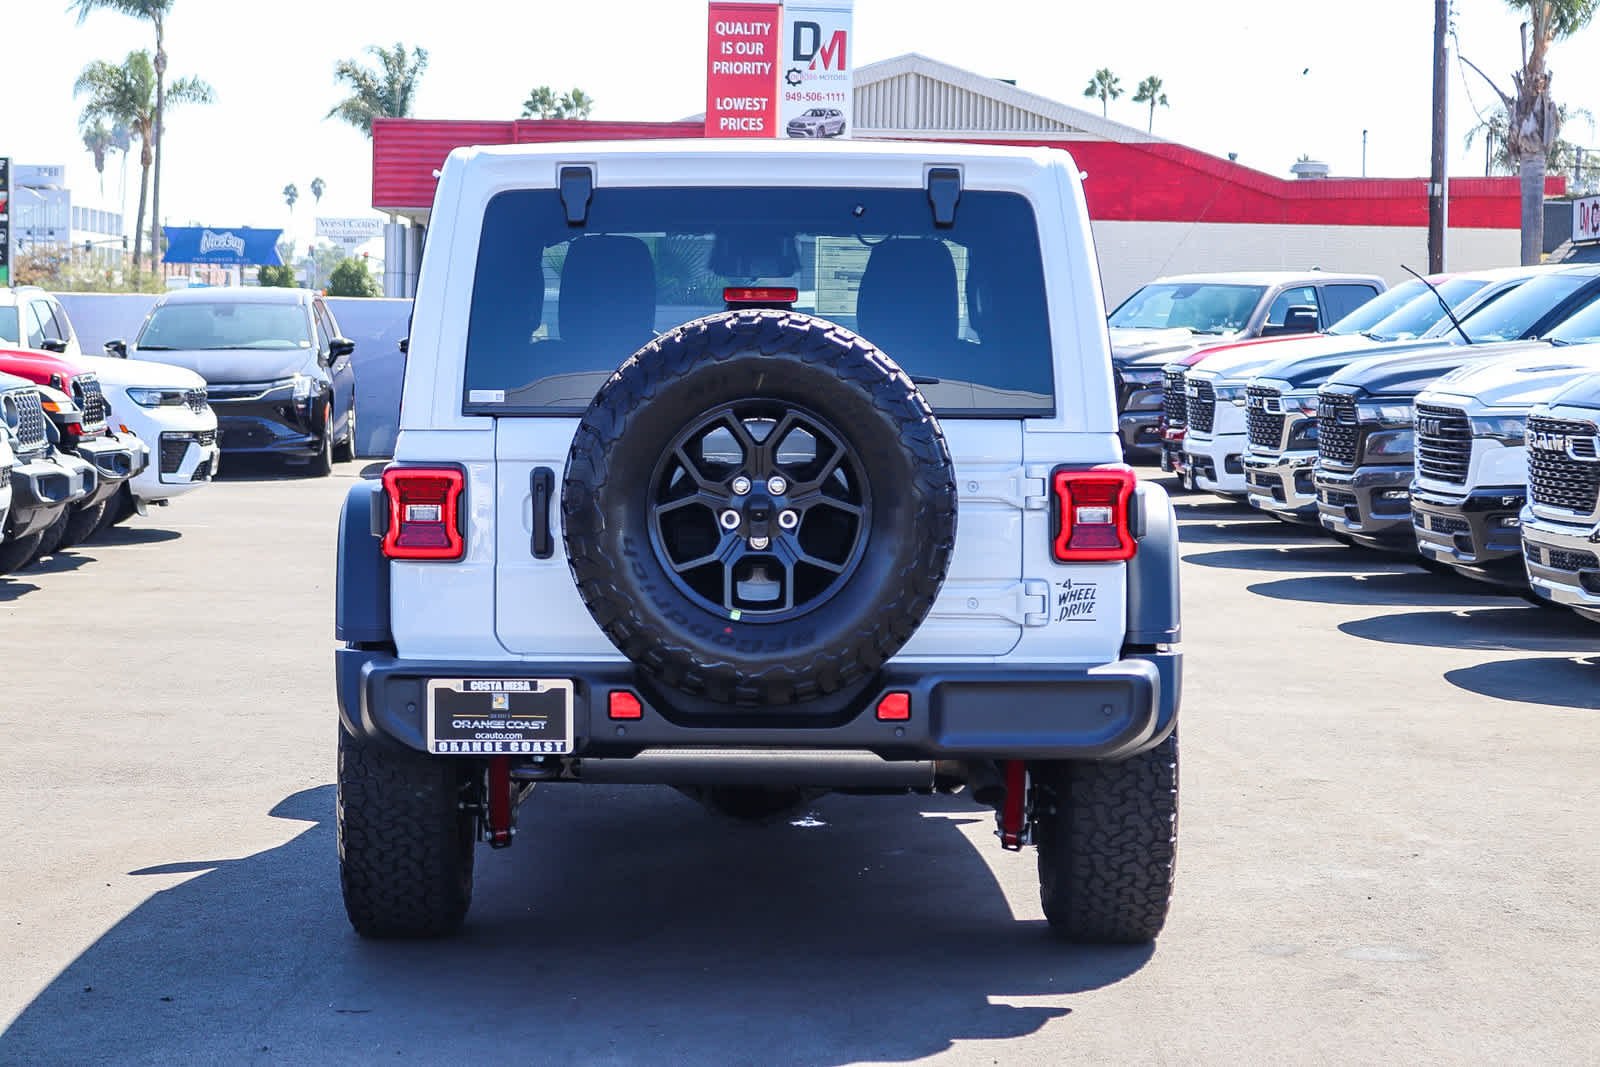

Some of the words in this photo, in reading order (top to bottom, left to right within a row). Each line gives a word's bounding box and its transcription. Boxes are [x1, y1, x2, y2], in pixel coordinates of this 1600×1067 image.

[715, 21, 771, 36] QUALITY
[721, 42, 733, 55] IS
[736, 42, 764, 55] OUR
[713, 61, 772, 75] PRIORITY
[785, 91, 846, 102] 949-506-1111
[716, 97, 768, 111] LOWEST
[720, 117, 764, 131] PRICES
[1062, 578, 1073, 590] 4
[1058, 587, 1097, 606] WHEEL
[1058, 601, 1096, 623] DRIVE
[470, 681, 502, 691] COSTA
[503, 681, 530, 691] MESA
[452, 720, 505, 730] ORANGE
[506, 720, 547, 730] COAST
[475, 732, 523, 740] ocauto.com
[439, 741, 503, 752] ORANGE
[510, 741, 564, 752] COAST
